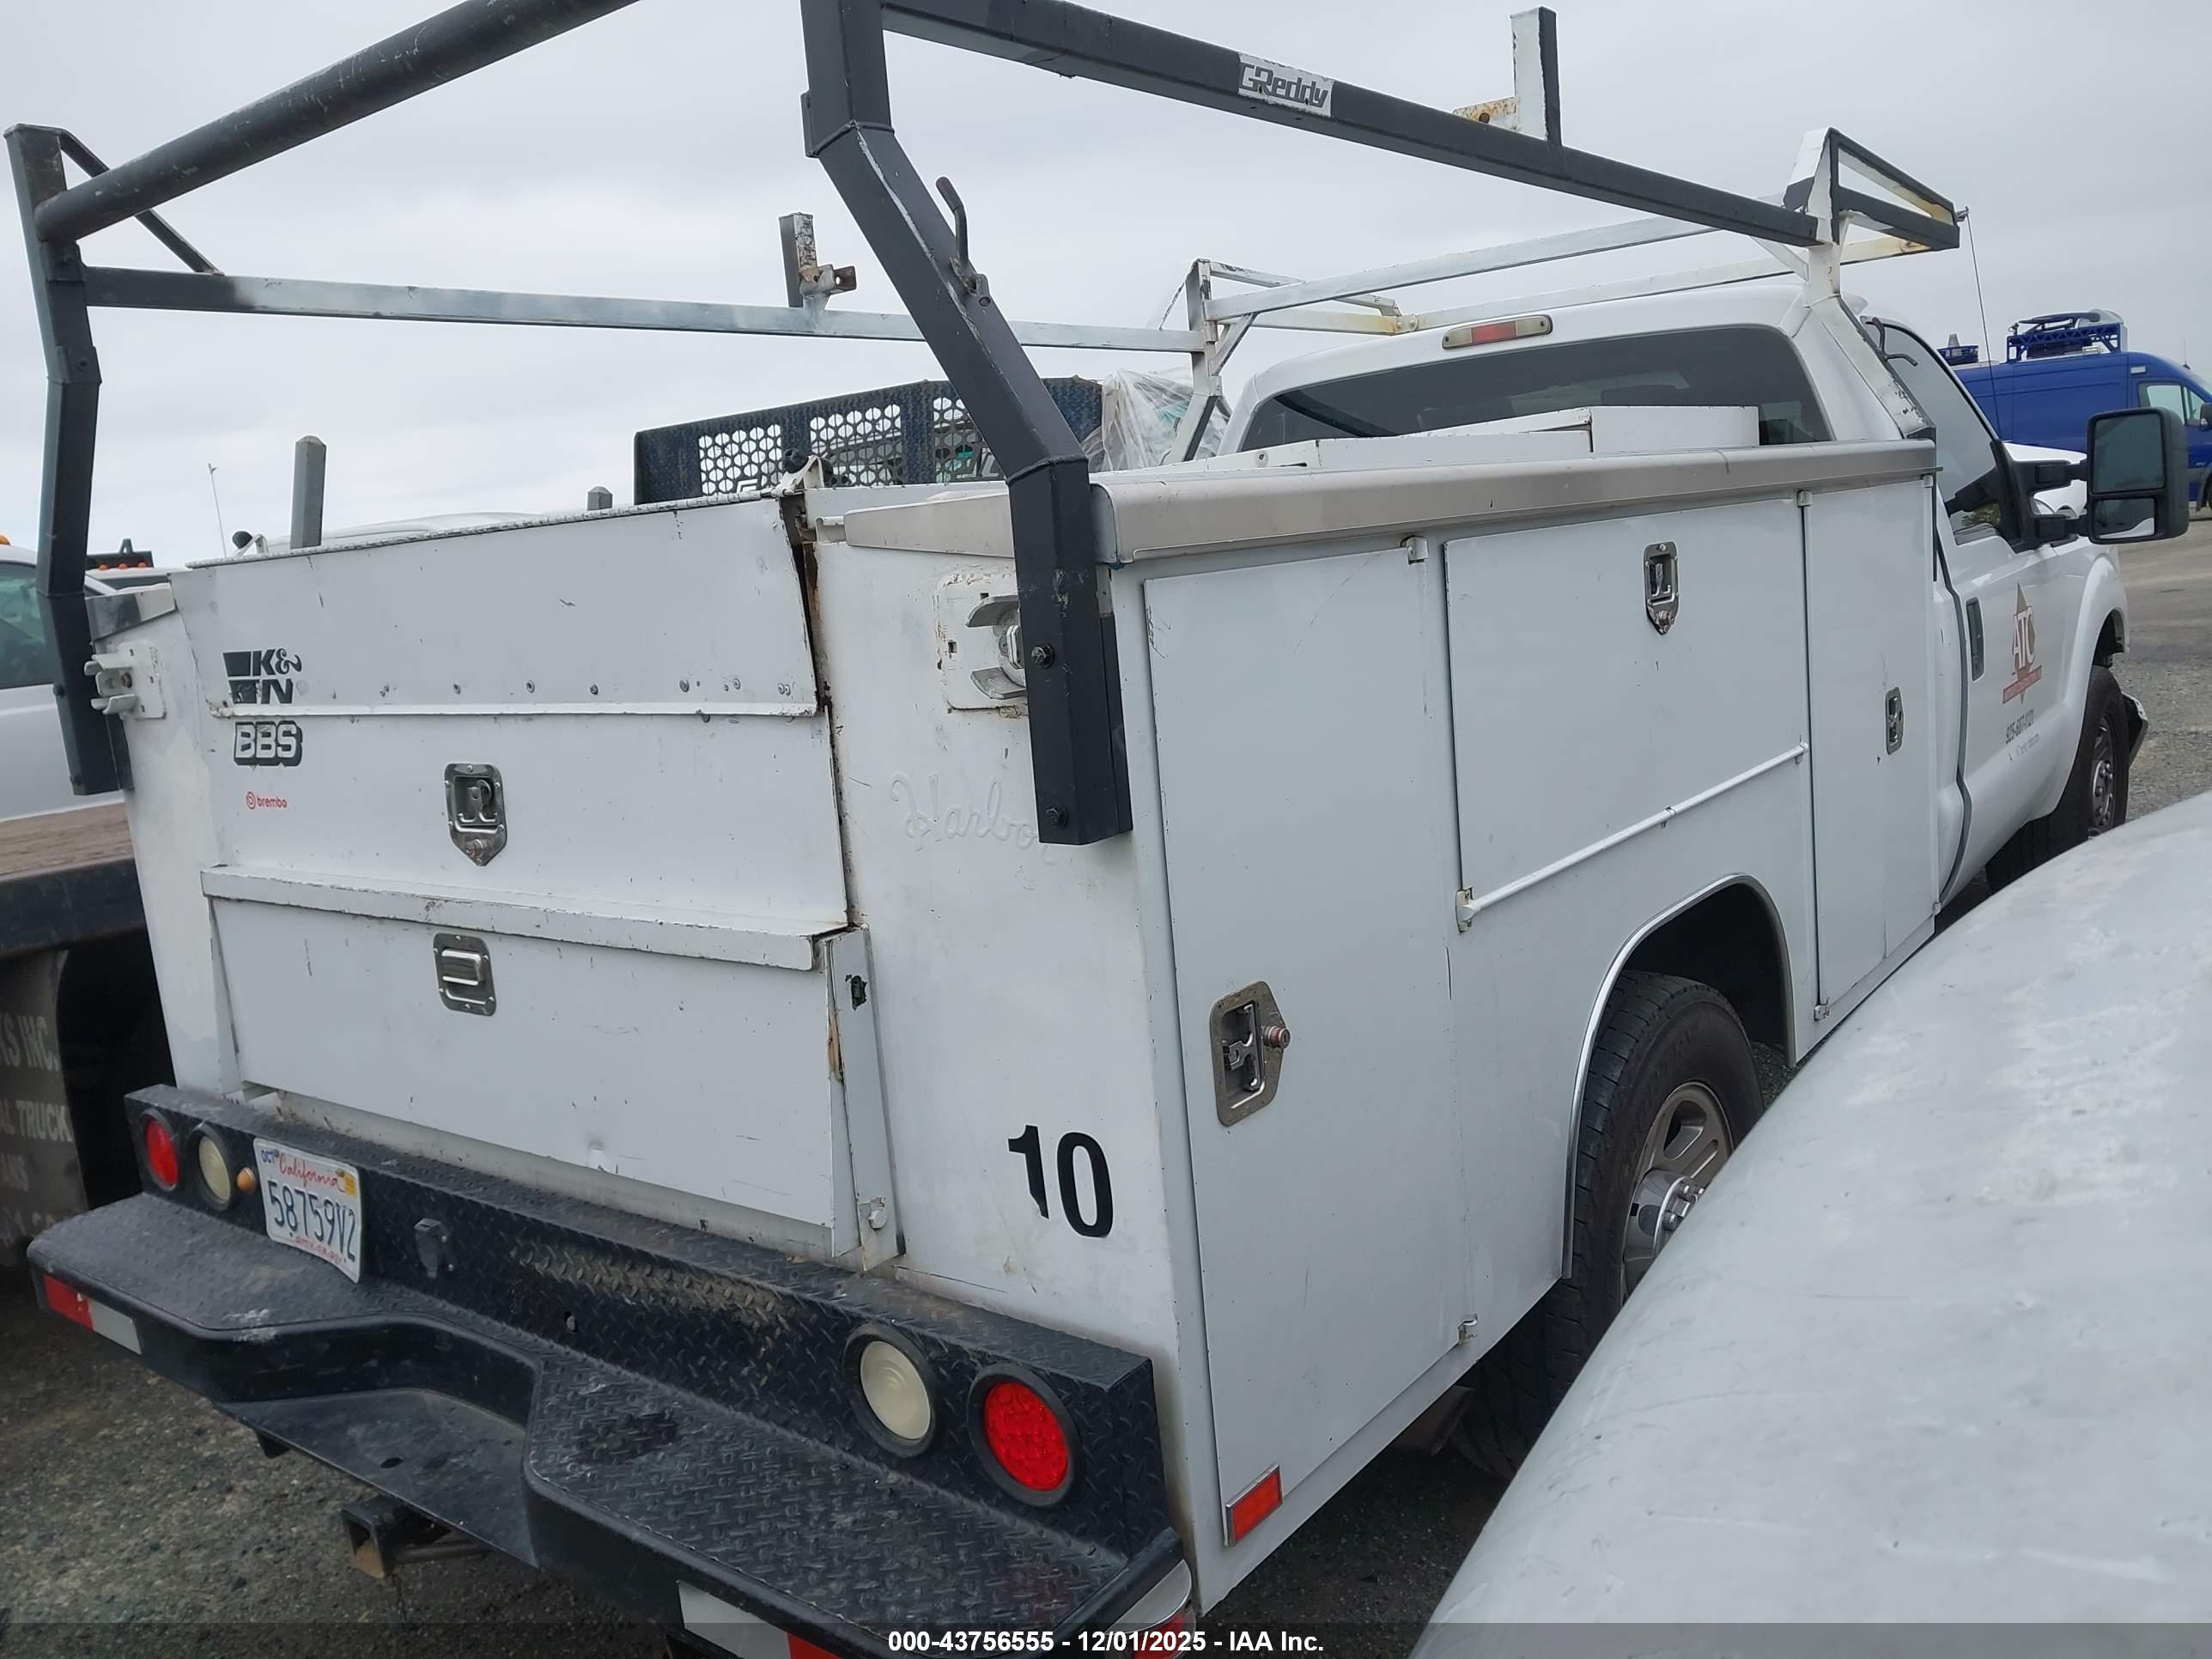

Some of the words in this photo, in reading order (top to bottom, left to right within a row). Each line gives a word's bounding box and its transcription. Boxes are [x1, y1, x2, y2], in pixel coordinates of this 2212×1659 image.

[2012, 606, 2036, 675] ATC
[234, 720, 303, 767] BBS
[257, 794, 288, 809] brembo
[890, 772, 1048, 859] Harbo
[15, 1099, 73, 1142] TRUCK
[279, 1152, 345, 1191] California
[1008, 1125, 1113, 1238] 10
[267, 1180, 356, 1262] 58759V2
